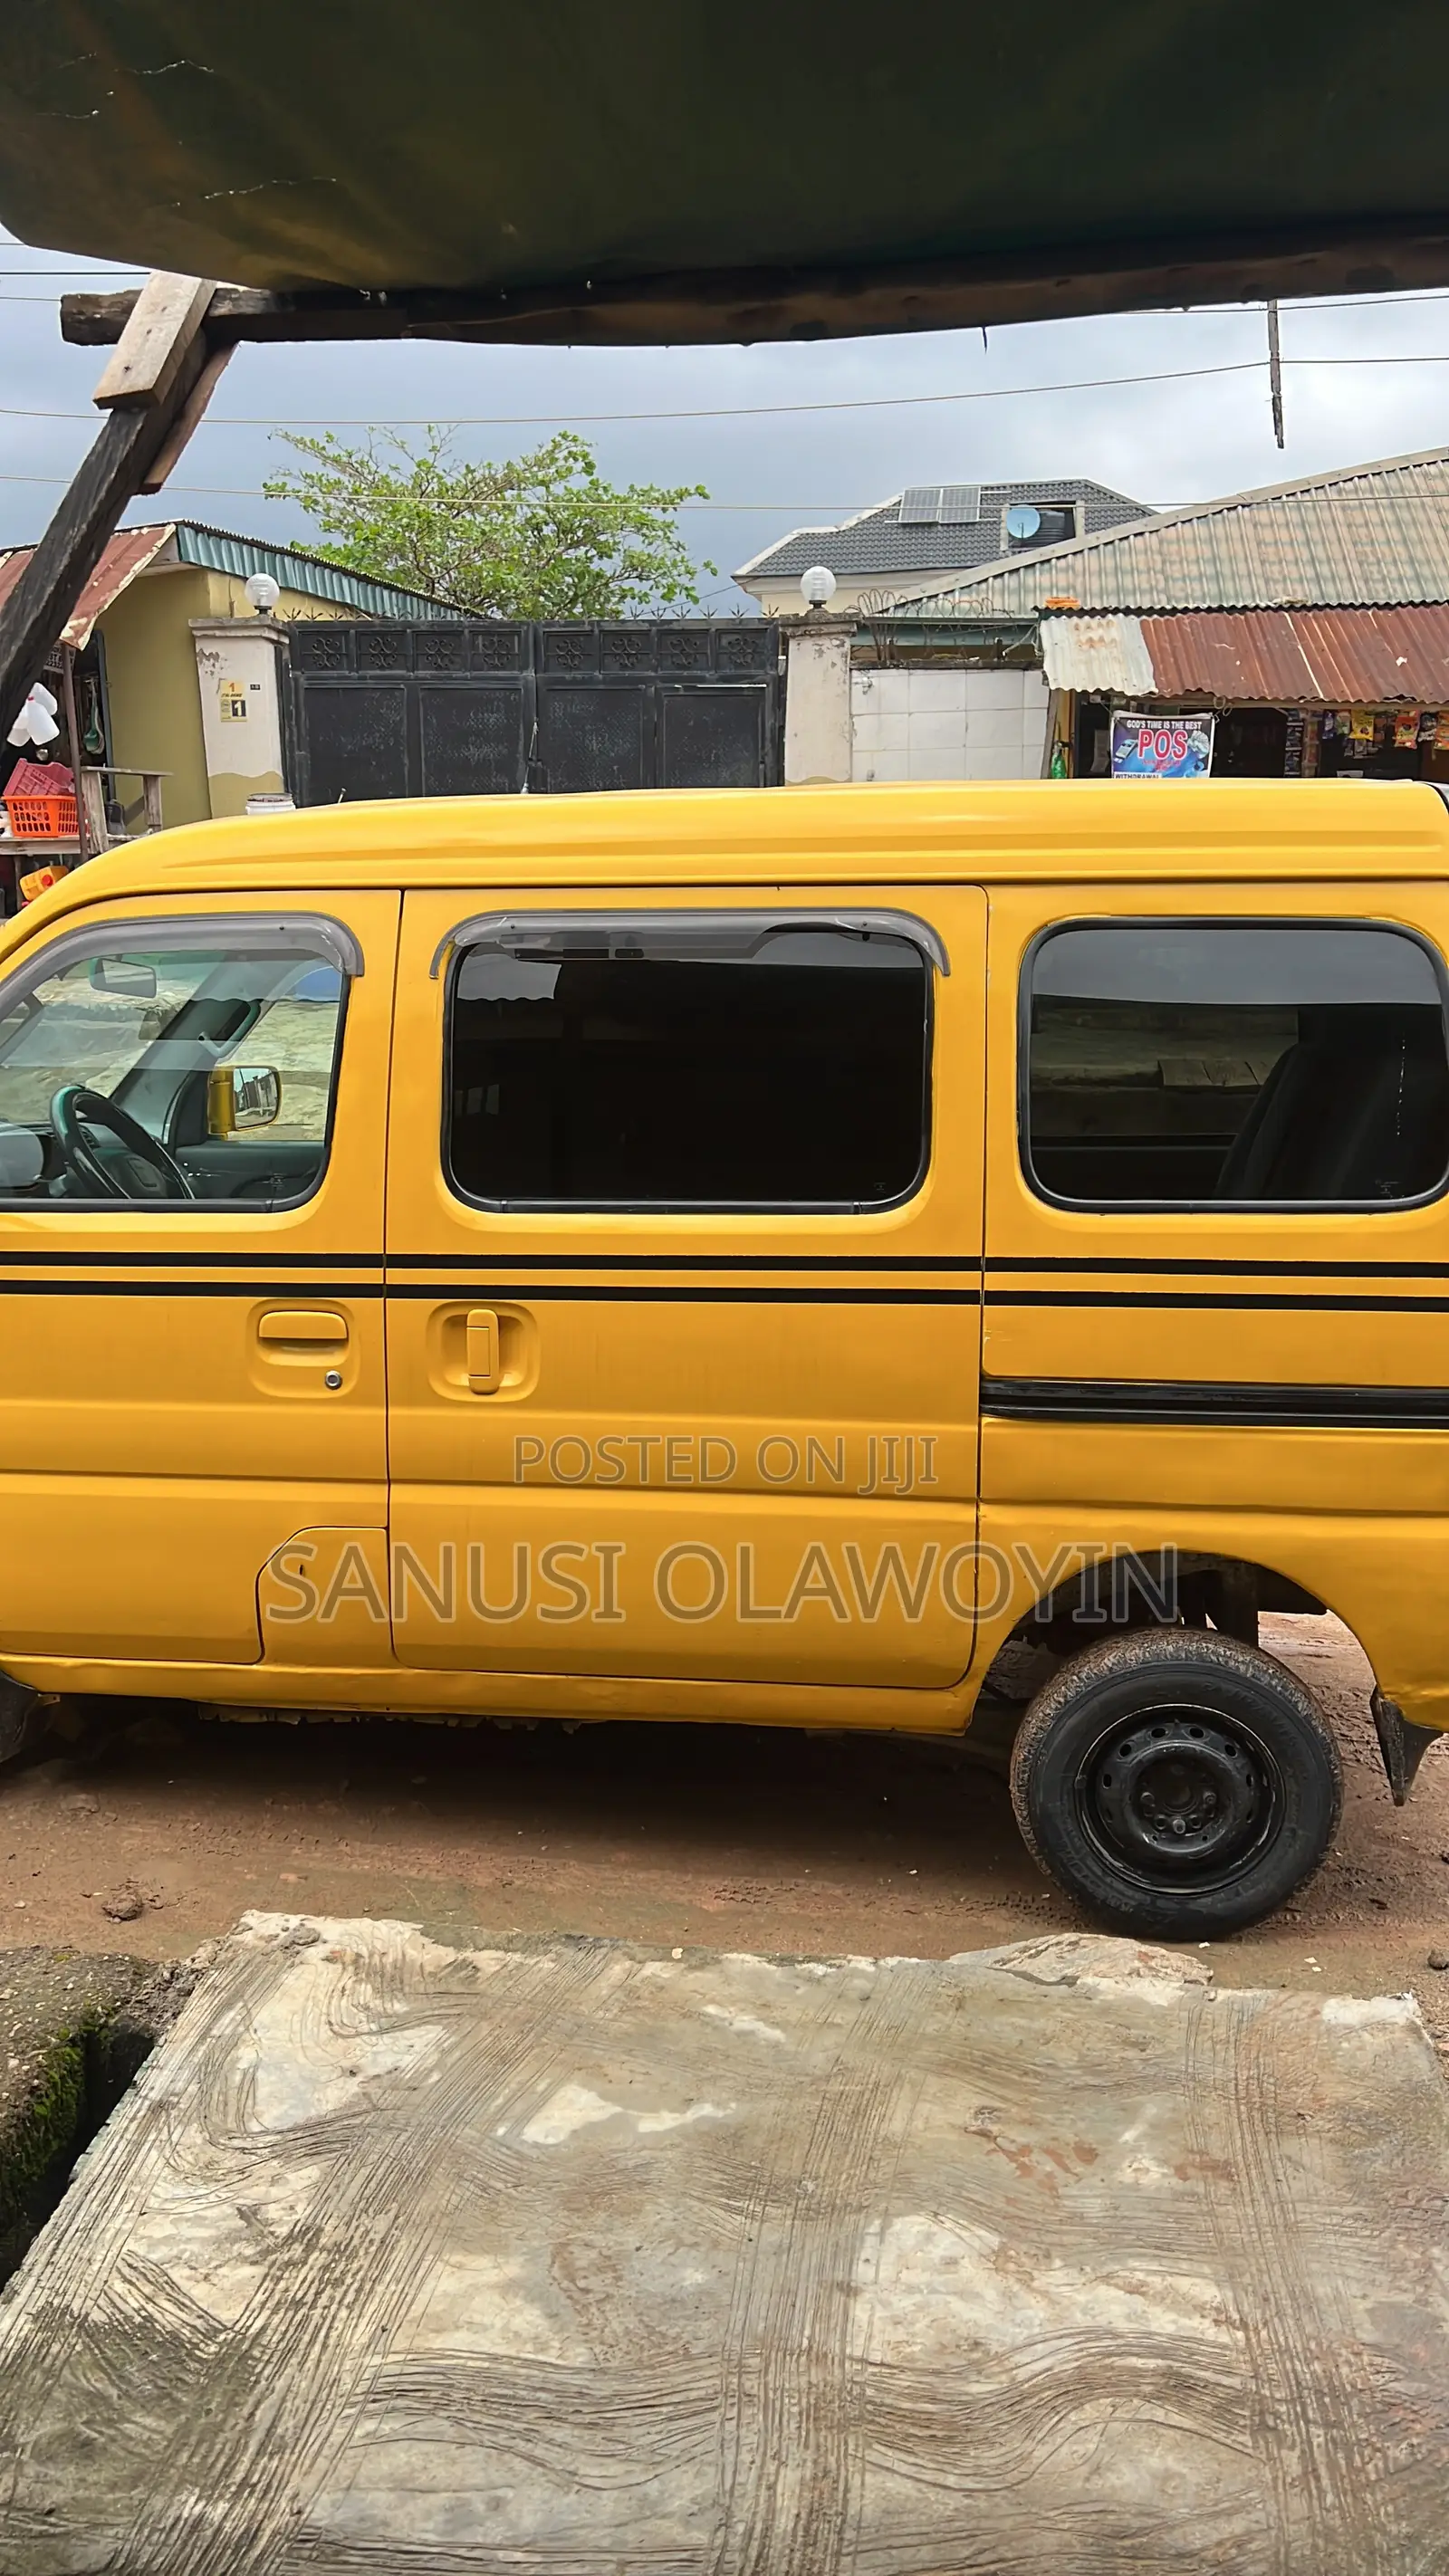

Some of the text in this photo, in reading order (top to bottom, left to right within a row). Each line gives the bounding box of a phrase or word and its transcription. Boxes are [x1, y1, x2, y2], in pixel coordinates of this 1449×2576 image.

[234, 700, 243, 716] 1
[1127, 720, 1146, 729] GOD'S
[1147, 721, 1162, 729] TIME
[1164, 721, 1170, 729] IS
[1185, 722, 1202, 730] BEST
[1137, 729, 1188, 760] POS
